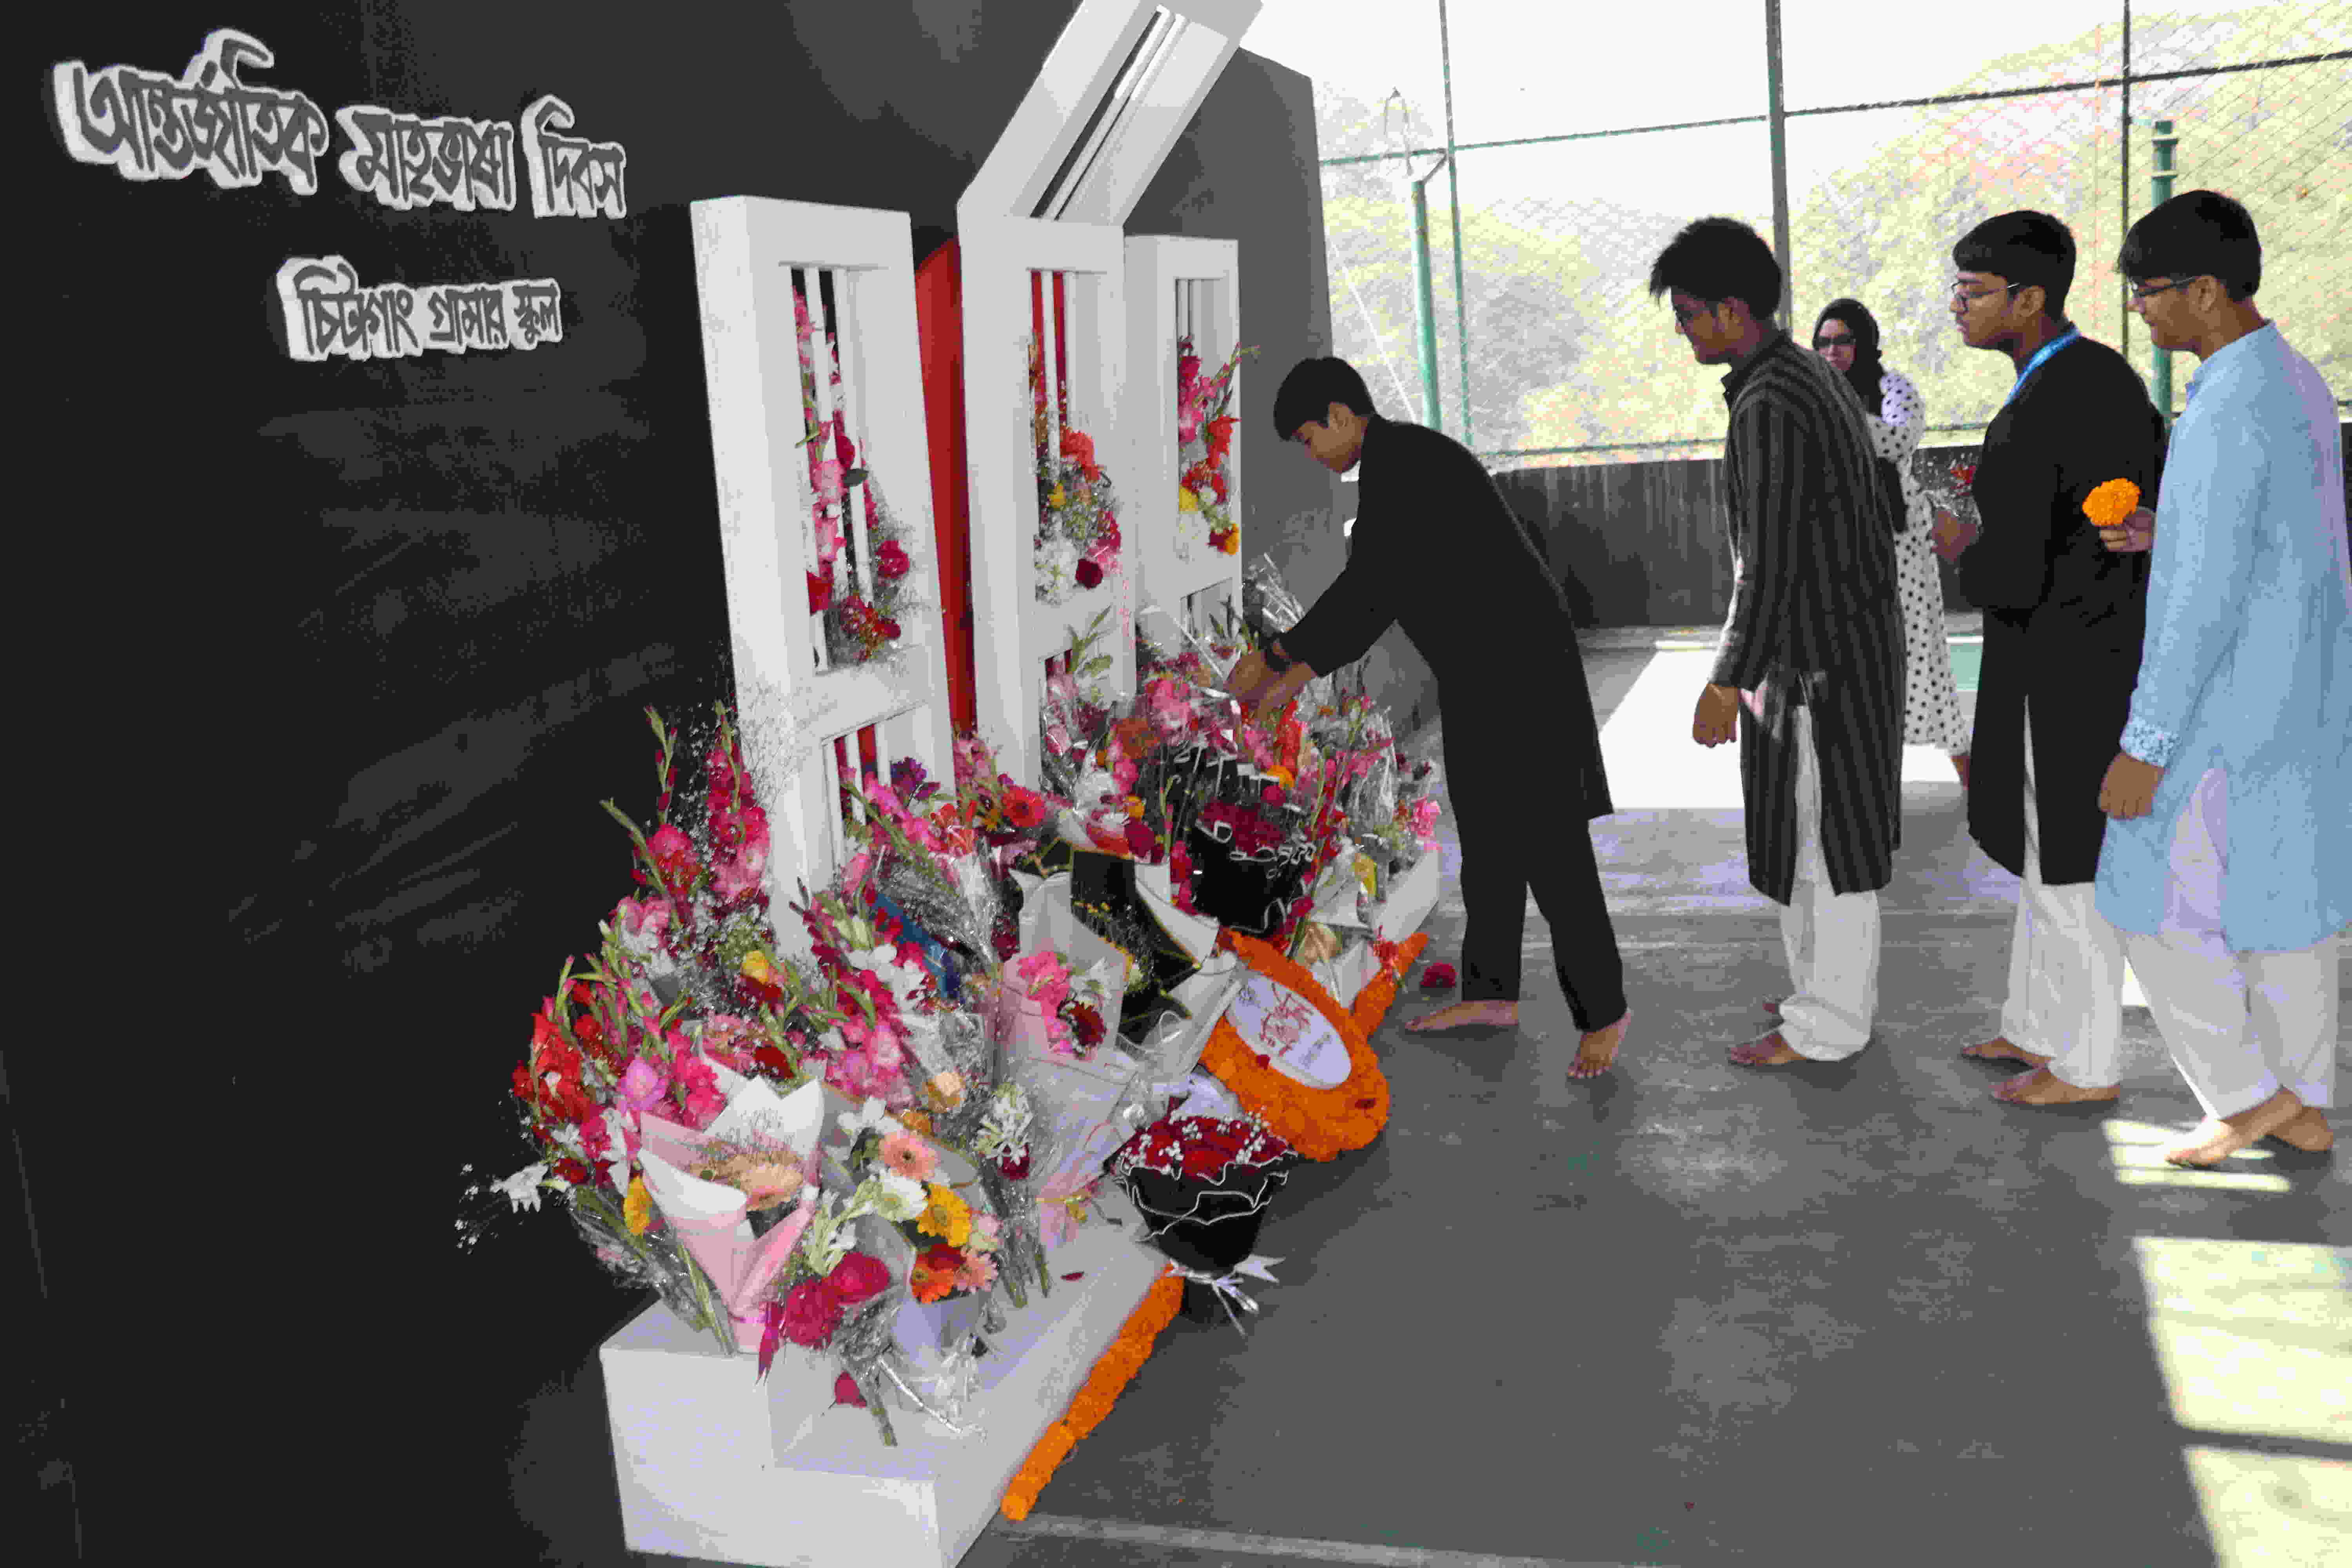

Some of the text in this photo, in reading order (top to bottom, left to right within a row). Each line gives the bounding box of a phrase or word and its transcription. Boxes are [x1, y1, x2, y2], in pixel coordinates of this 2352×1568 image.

[54, 29, 627, 219] আন্তর্জাতিক মাতৃভাষা দিবস
[276, 255, 563, 361] চিটাগাং গ্রামার স্কুল
